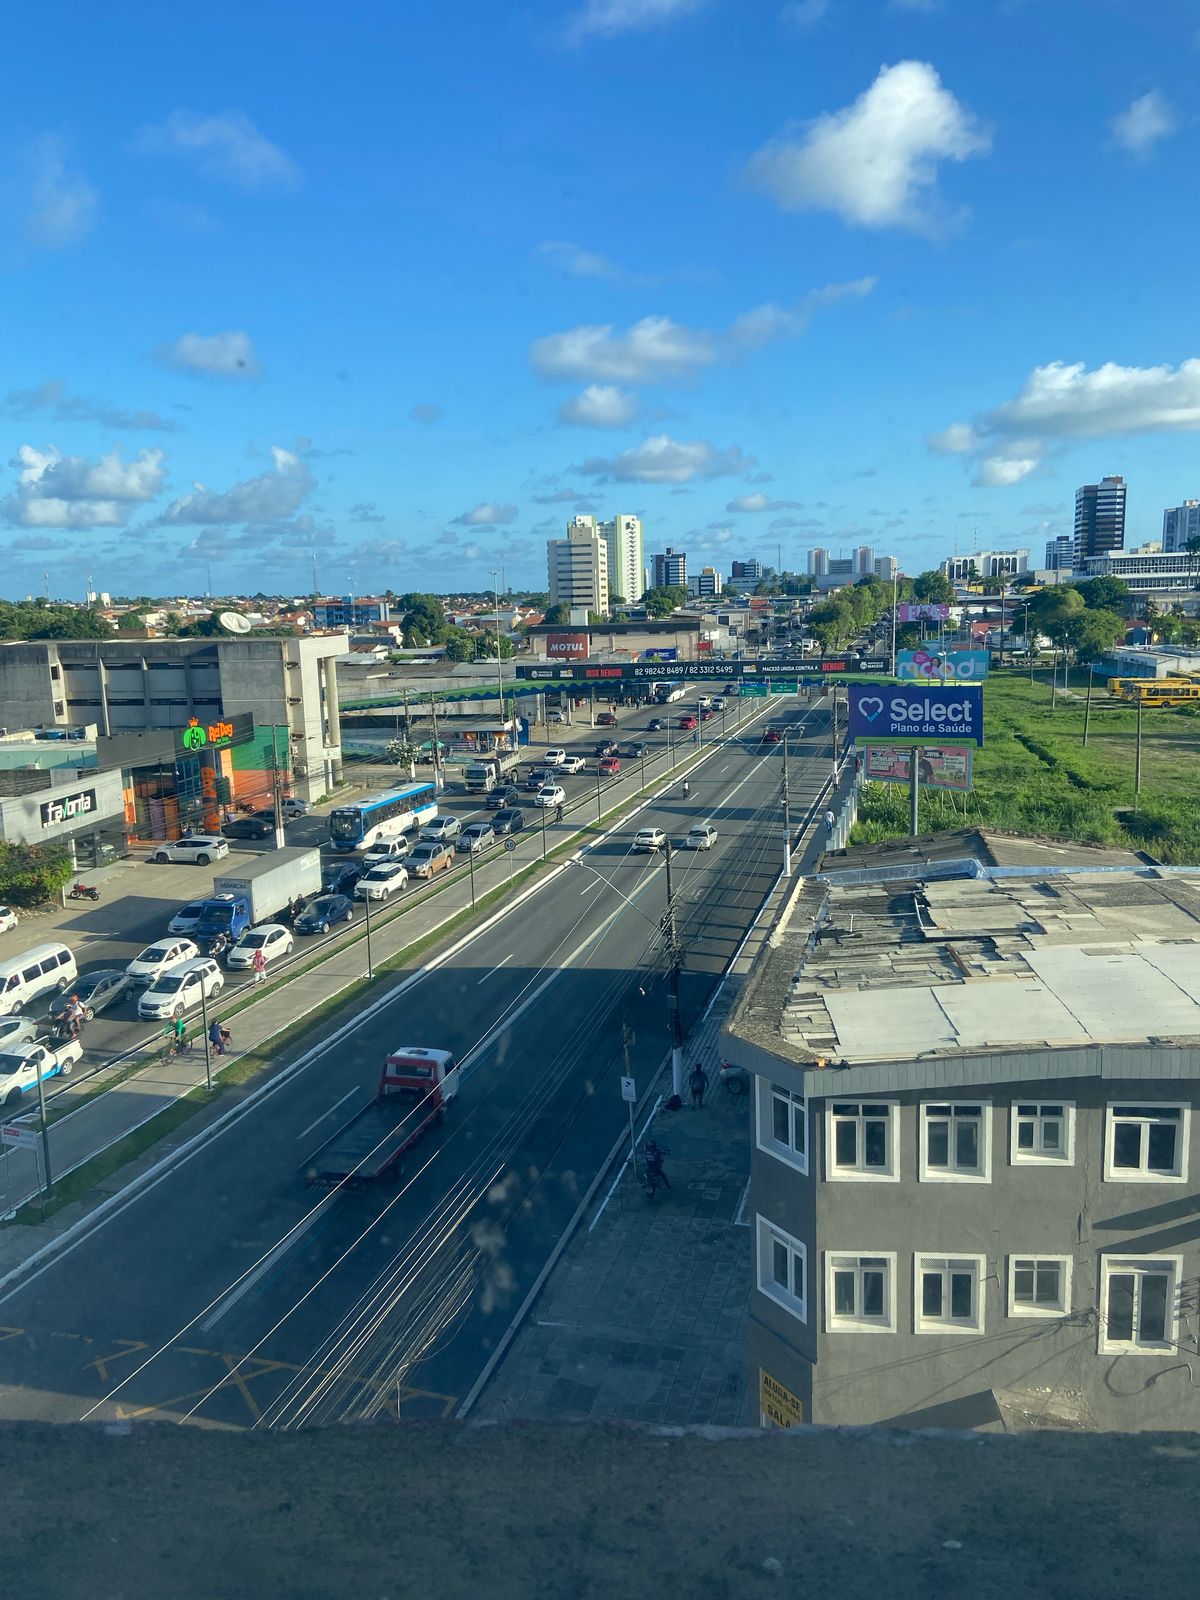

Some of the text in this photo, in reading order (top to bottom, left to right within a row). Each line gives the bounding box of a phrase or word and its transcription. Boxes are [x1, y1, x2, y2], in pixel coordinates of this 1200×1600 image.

[550, 643, 584, 651] MOTUL
[634, 668, 643, 676] 82
[645, 667, 665, 675] 98242
[689, 666, 698, 674] 82
[699, 666, 714, 674] 3312
[716, 665, 733, 673] 5495
[762, 664, 780, 672] MACEIÓ
[822, 662, 846, 671] DENGUE
[586, 669, 623, 677] DISK DENGUE
[890, 698, 973, 722] Select
[890, 723, 972, 733] Plano de Saúde
